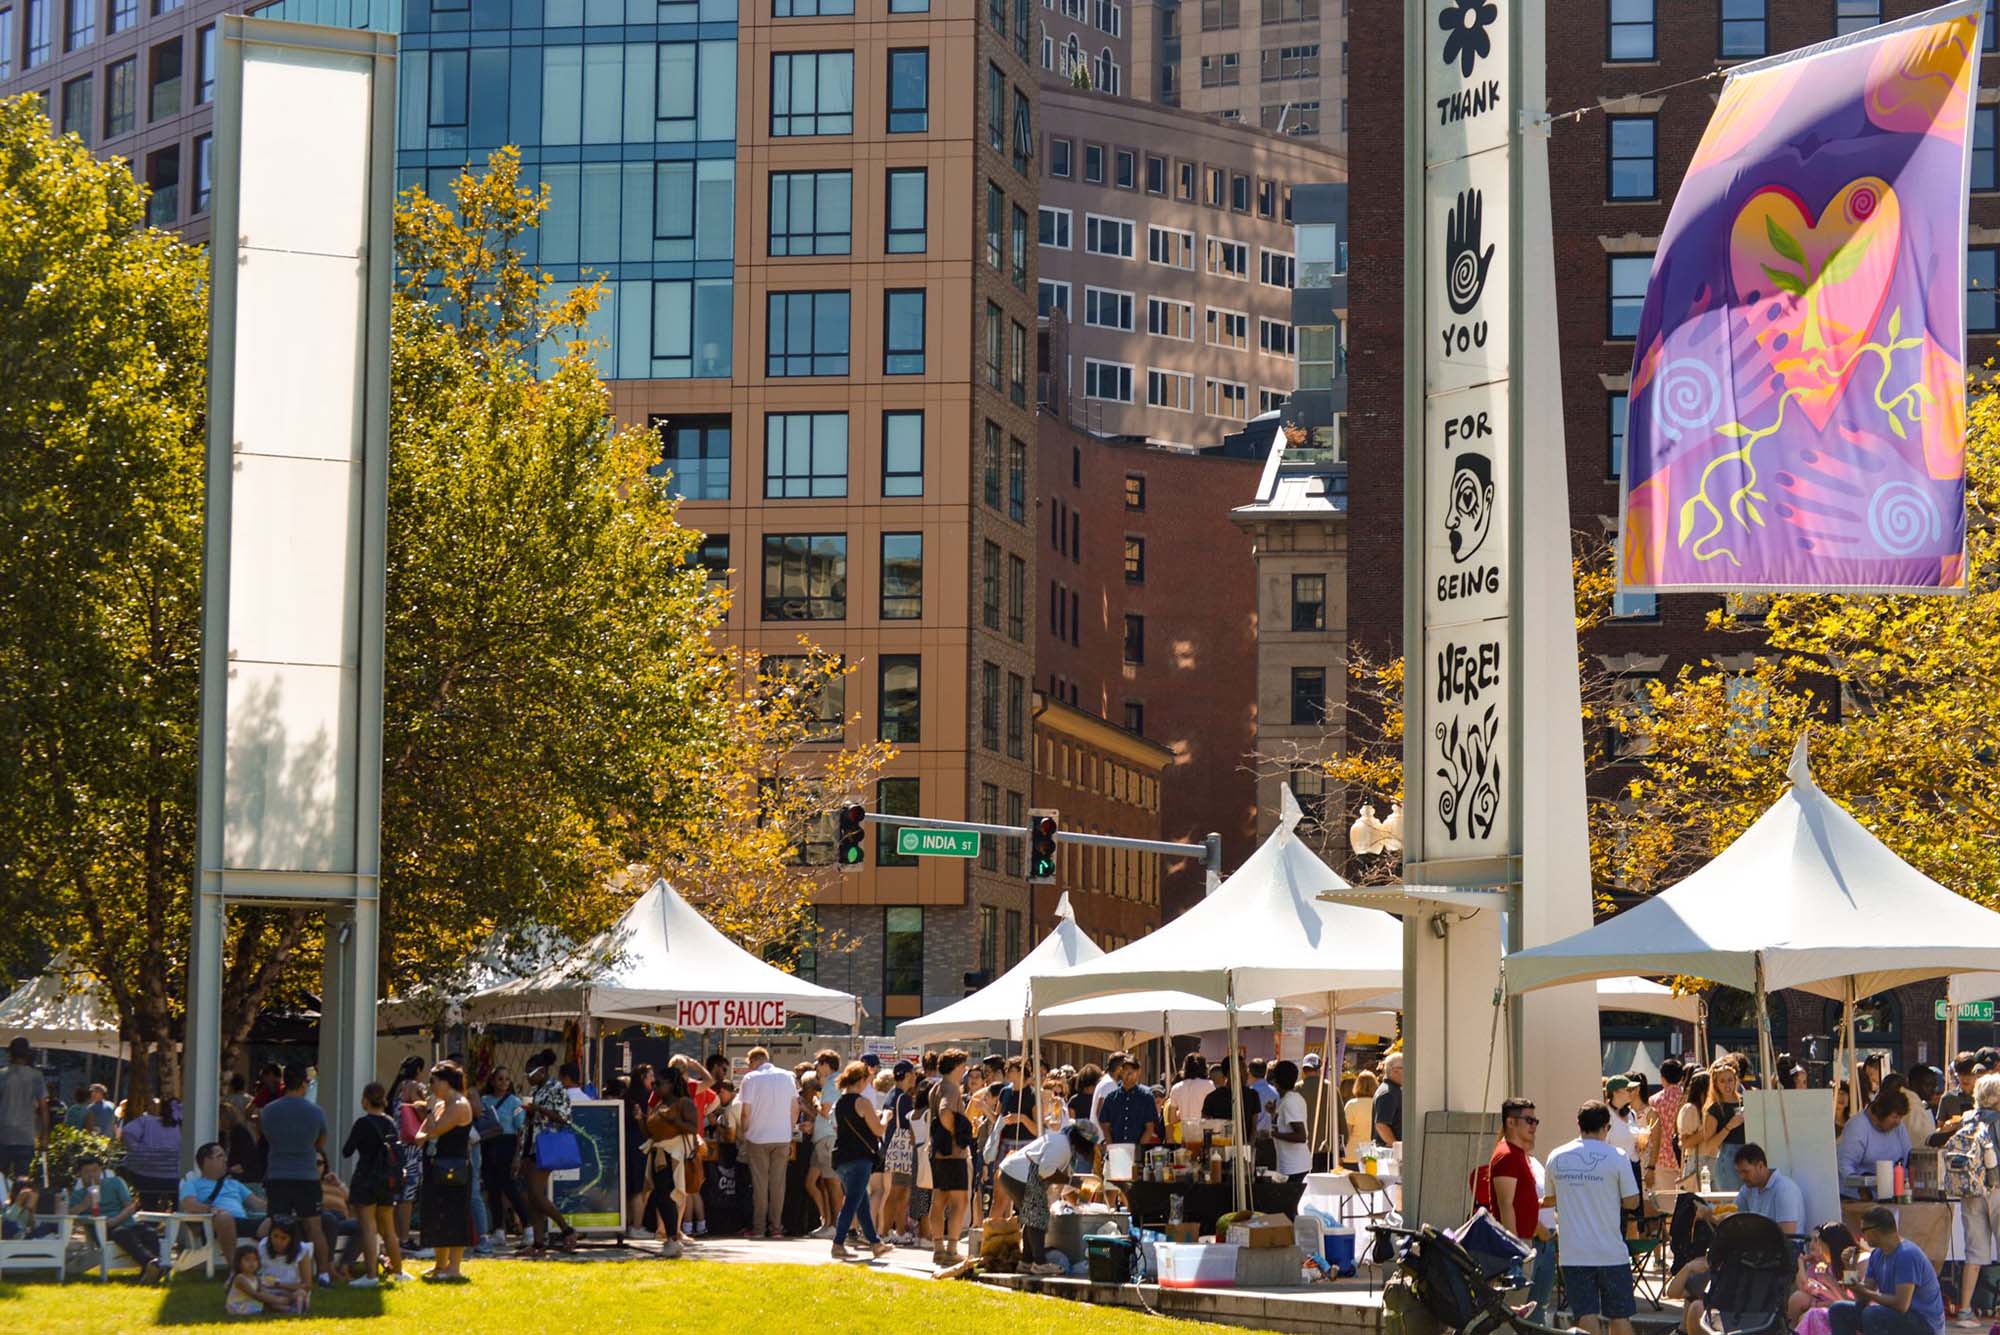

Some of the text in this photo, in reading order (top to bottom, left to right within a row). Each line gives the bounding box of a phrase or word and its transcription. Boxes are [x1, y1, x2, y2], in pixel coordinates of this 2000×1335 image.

[1437, 80, 1500, 126] THANK
[1442, 321, 1488, 358] YOU
[1445, 412, 1492, 450] FOR
[1437, 566, 1499, 602] BEING
[1437, 642, 1500, 706] HERE!
[923, 835, 973, 851] INDIA ST
[679, 1000, 784, 1026] HOT SAUCE
[1958, 1004, 1992, 1017] NDIA ST
